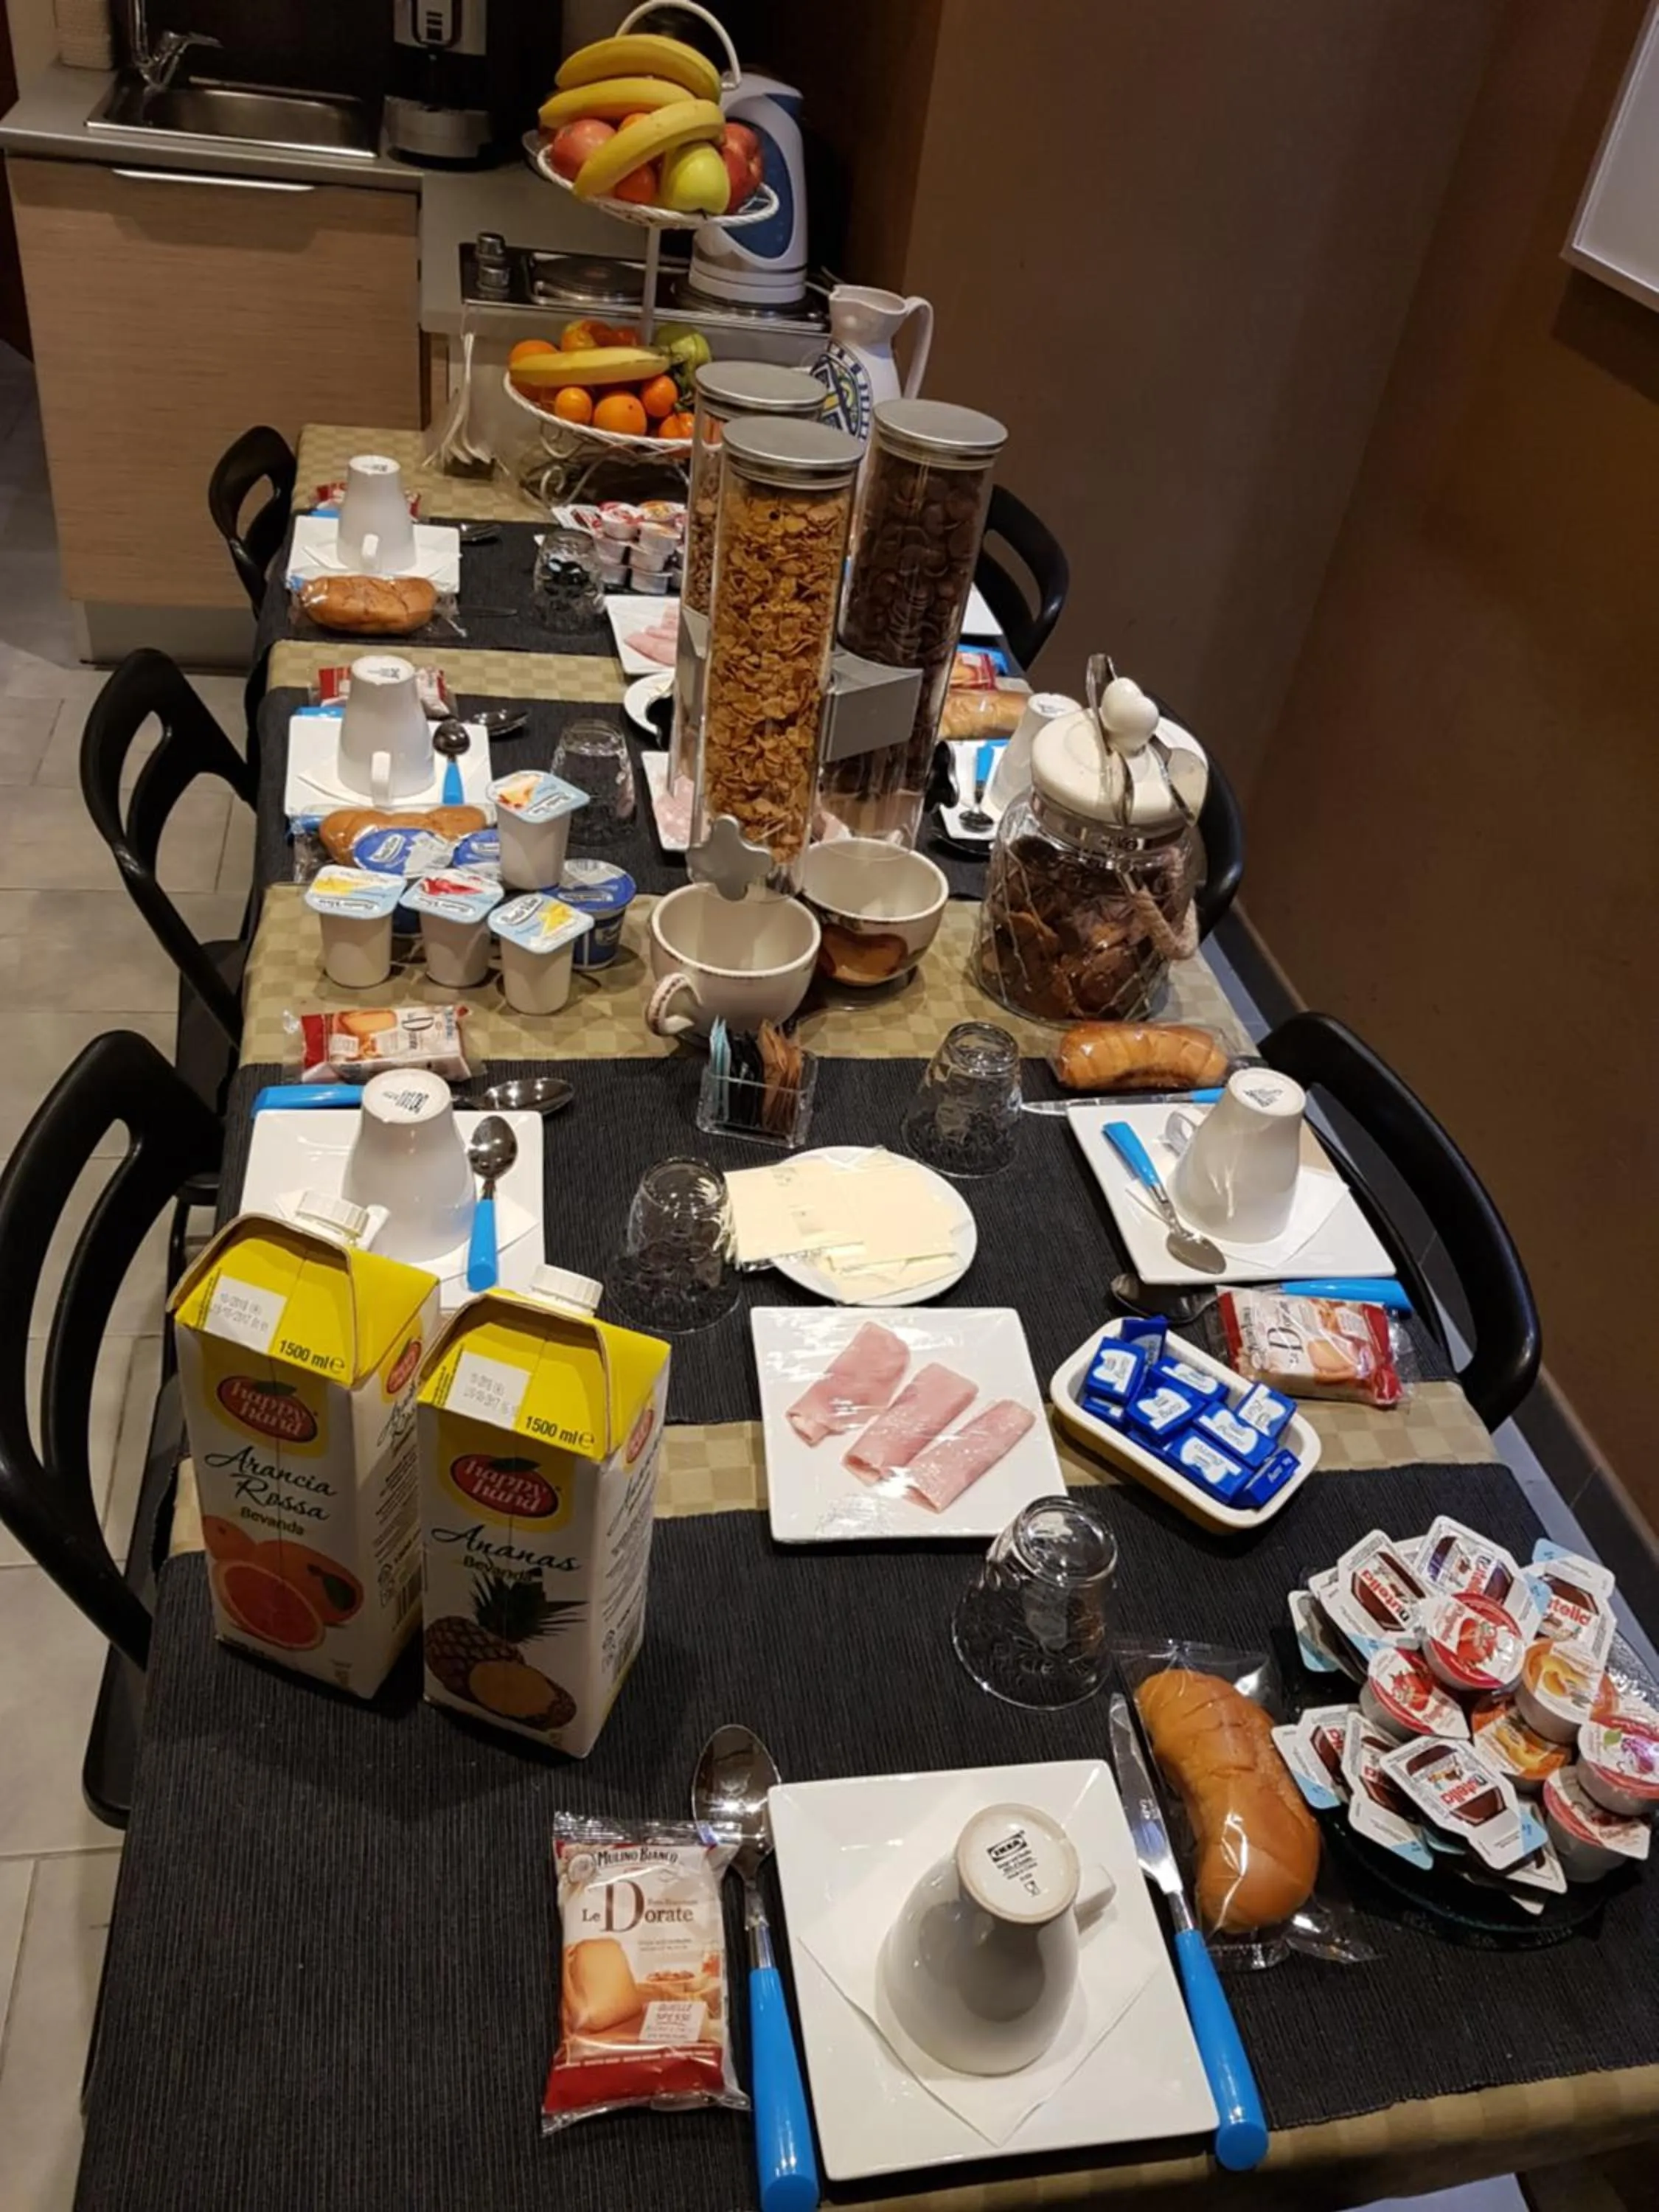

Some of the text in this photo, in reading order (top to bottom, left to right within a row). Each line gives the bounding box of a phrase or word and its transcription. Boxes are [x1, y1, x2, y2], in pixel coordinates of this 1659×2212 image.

[279, 1340, 311, 1362] 1500
[231, 1381, 307, 1423] happy
[526, 1416, 557, 1438] 1500
[204, 1445, 338, 1496] Arancia
[465, 1460, 549, 1500] happy
[229, 1472, 331, 1520] Rossa
[240, 1506, 305, 1537] Bevanda
[431, 1524, 582, 1572] Ananas
[1361, 1568, 1411, 1622] nutella
[1547, 1599, 1593, 1627] tella
[1440, 1774, 1488, 1805] nutella
[994, 1839, 1021, 1857] IKEA
[582, 1879, 695, 1934] Le Dorate
